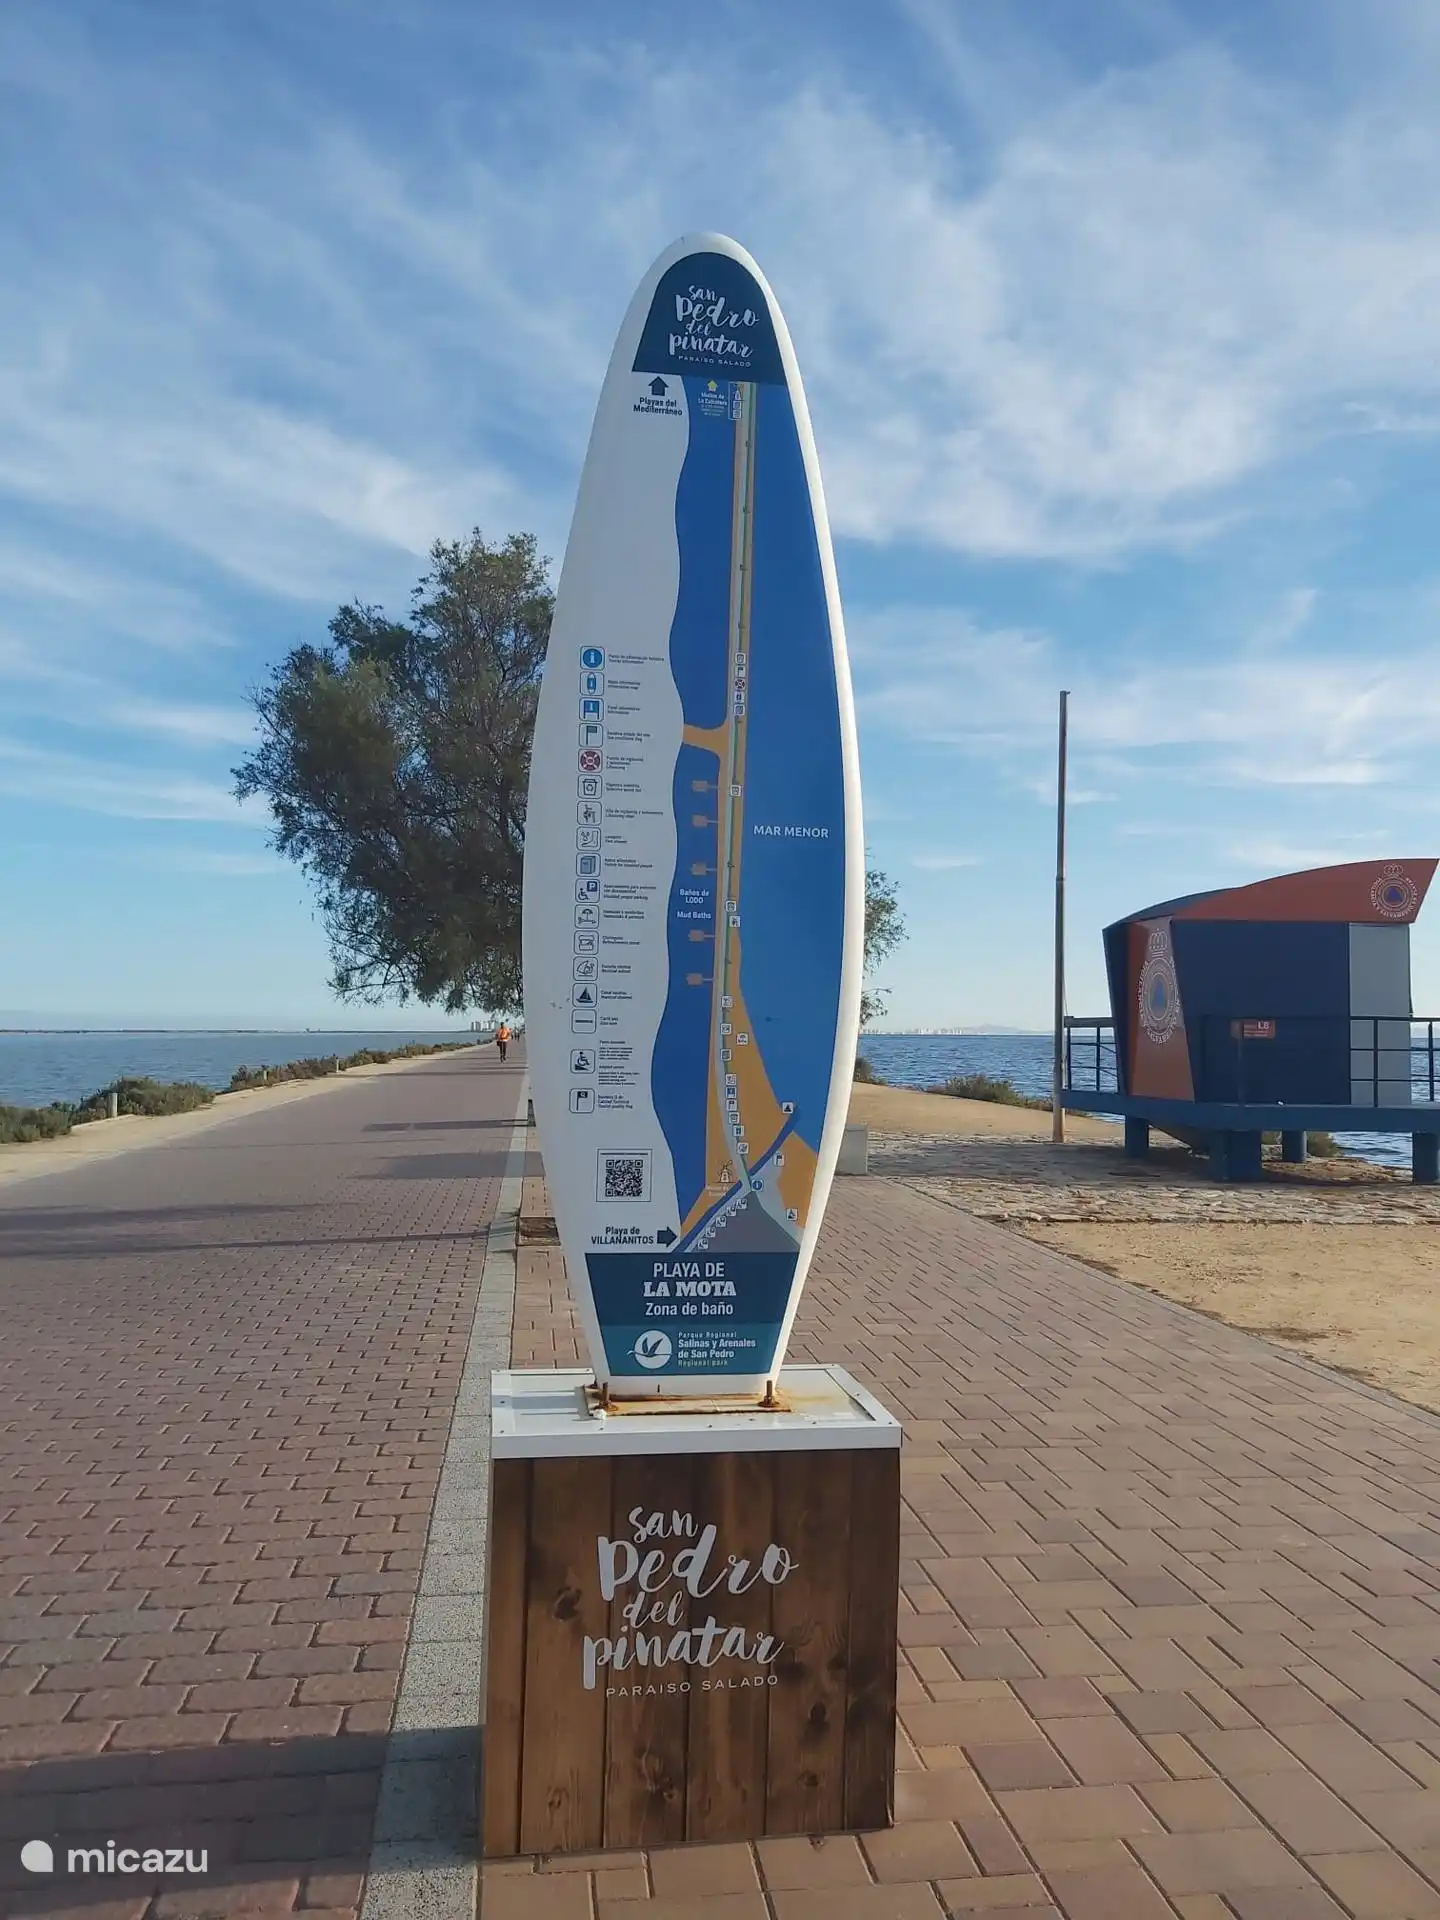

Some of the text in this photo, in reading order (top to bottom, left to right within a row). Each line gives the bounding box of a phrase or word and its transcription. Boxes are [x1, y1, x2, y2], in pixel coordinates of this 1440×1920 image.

[688, 284, 717, 301] san
[675, 294, 760, 328] Pedro
[685, 318, 712, 336] del
[718, 359, 752, 368] SALADO
[639, 396, 677, 408] Playas del
[753, 824, 830, 839] MAR MENOR
[685, 896, 704, 904] LODO
[701, 888, 710, 897] de
[676, 911, 712, 920] Mud Baths
[605, 1226, 641, 1237] Playa de
[653, 1262, 725, 1278] PLAYA DE
[643, 1281, 737, 1297] LA MOTA
[645, 1301, 734, 1316] Zona de baño
[705, 1331, 737, 1339] Regional
[678, 1338, 756, 1349] Salinas y Arenales
[677, 1349, 735, 1359] de San Pedro
[628, 1506, 699, 1543] san
[597, 1524, 800, 1601] Pedro
[622, 1590, 684, 1629] del
[583, 1616, 785, 1690] pinatar
[606, 1675, 778, 1698] PARAISO SALADO
